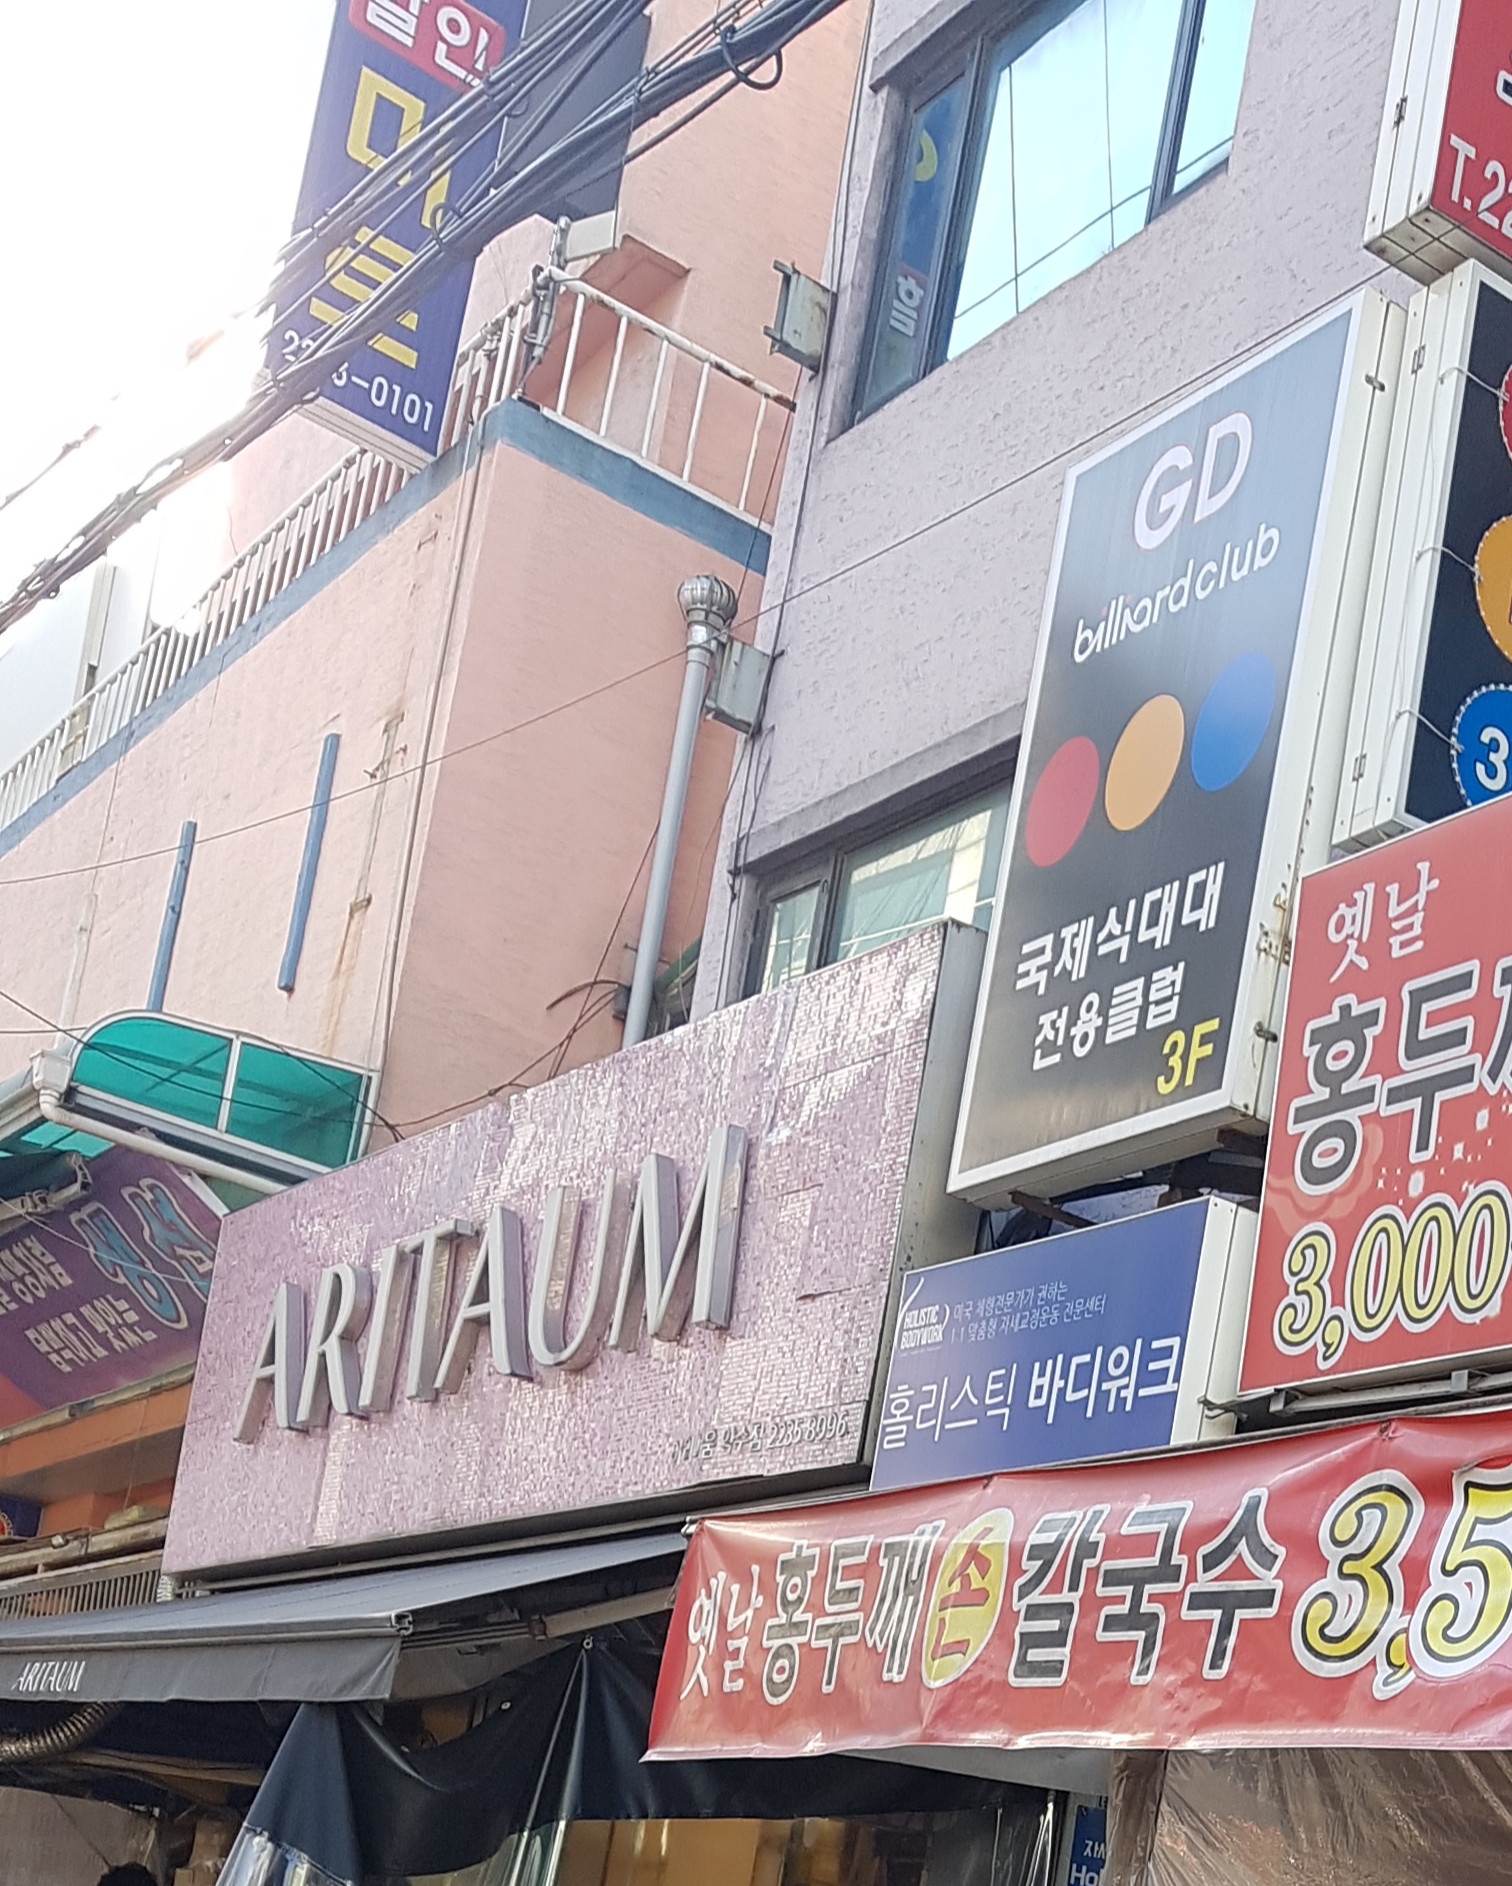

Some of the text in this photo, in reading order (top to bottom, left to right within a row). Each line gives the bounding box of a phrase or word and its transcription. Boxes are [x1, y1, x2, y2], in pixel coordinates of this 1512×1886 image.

[1134, 410, 1253, 550] GD
[1015, 862, 1225, 995] 국제식대대
[1327, 862, 1440, 984] 옛날
[1033, 961, 1185, 1071] 전용클럽
[1157, 1018, 1219, 1095] 3F
[233, 1124, 749, 1444] ARITAUM
[901, 1325, 943, 1350] BODYWORK
[883, 1335, 1181, 1451] 홀리스틱 바디워크
[679, 1565, 762, 1700] 옛날
[762, 1519, 945, 1705] 홍두깨
[929, 1522, 992, 1666] 손
[1007, 1488, 1286, 1688] 칼국수
[11, 1661, 85, 1692] ARITAUM
